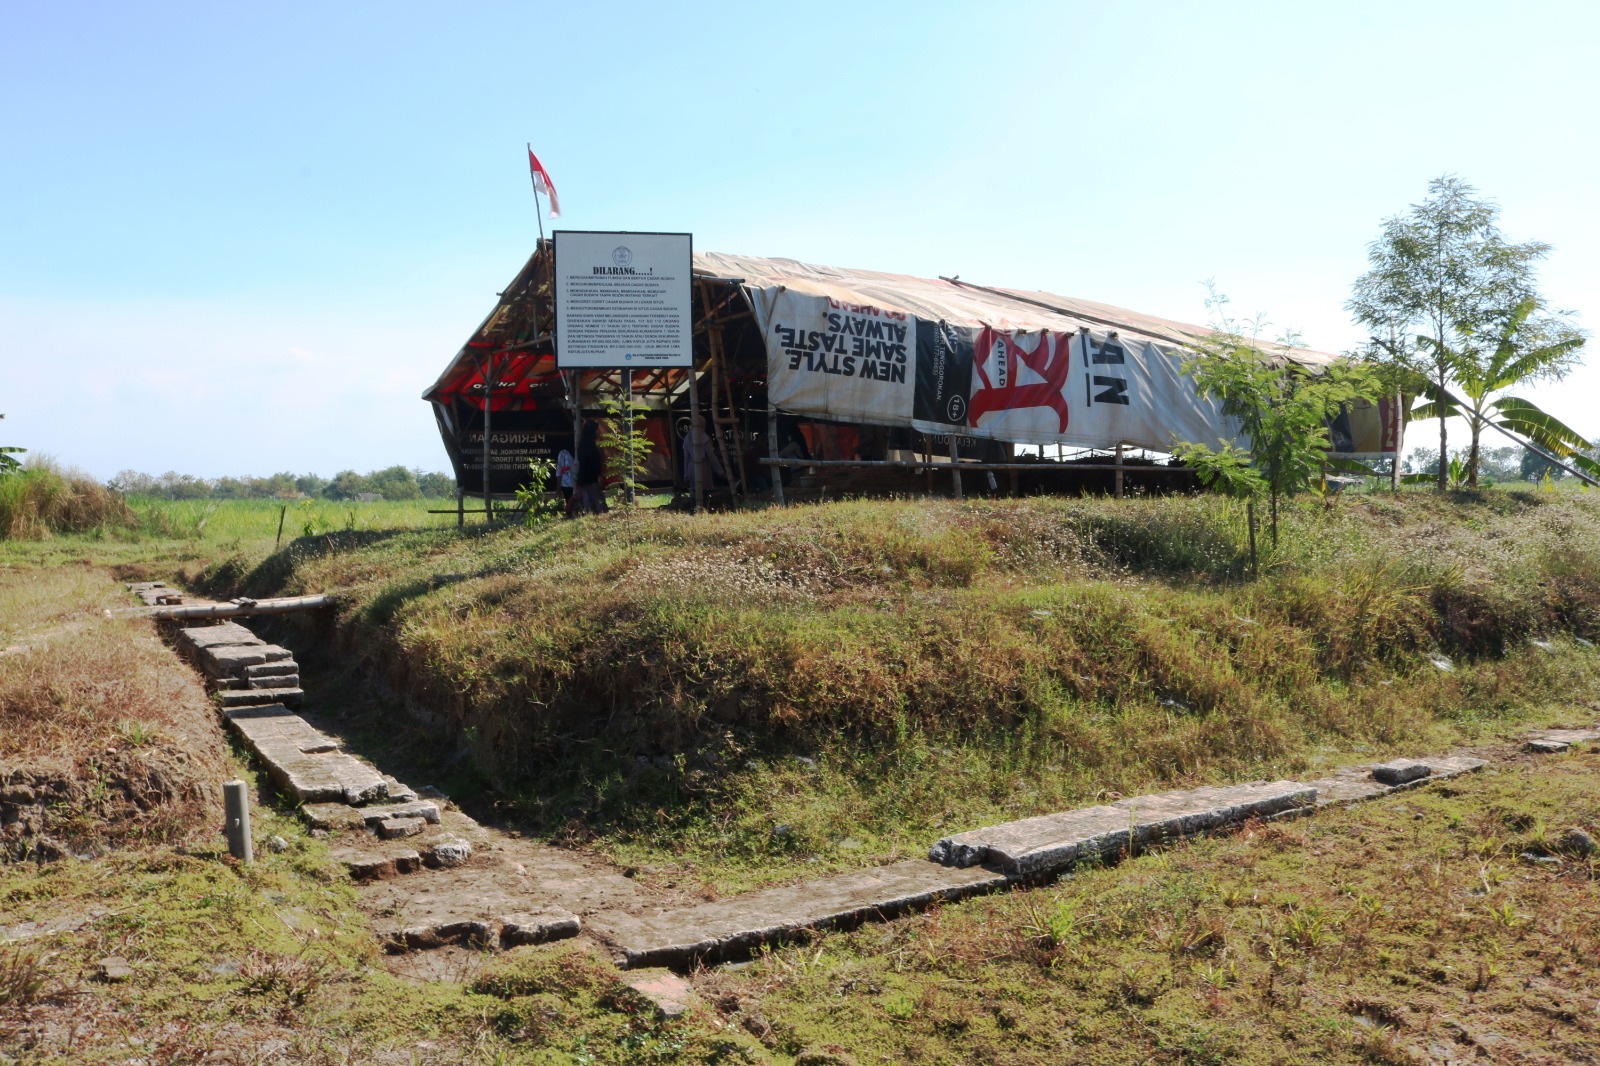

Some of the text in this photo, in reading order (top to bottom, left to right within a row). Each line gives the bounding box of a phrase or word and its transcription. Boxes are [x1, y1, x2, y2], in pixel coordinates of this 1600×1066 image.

[775, 323, 907, 363] SAME TASTE,
[822, 312, 908, 343] ALWAYS.
[785, 349, 906, 384] NEW STYLE.
[996, 341, 1006, 386] AHEAD
[952, 397, 960, 418] 18+
